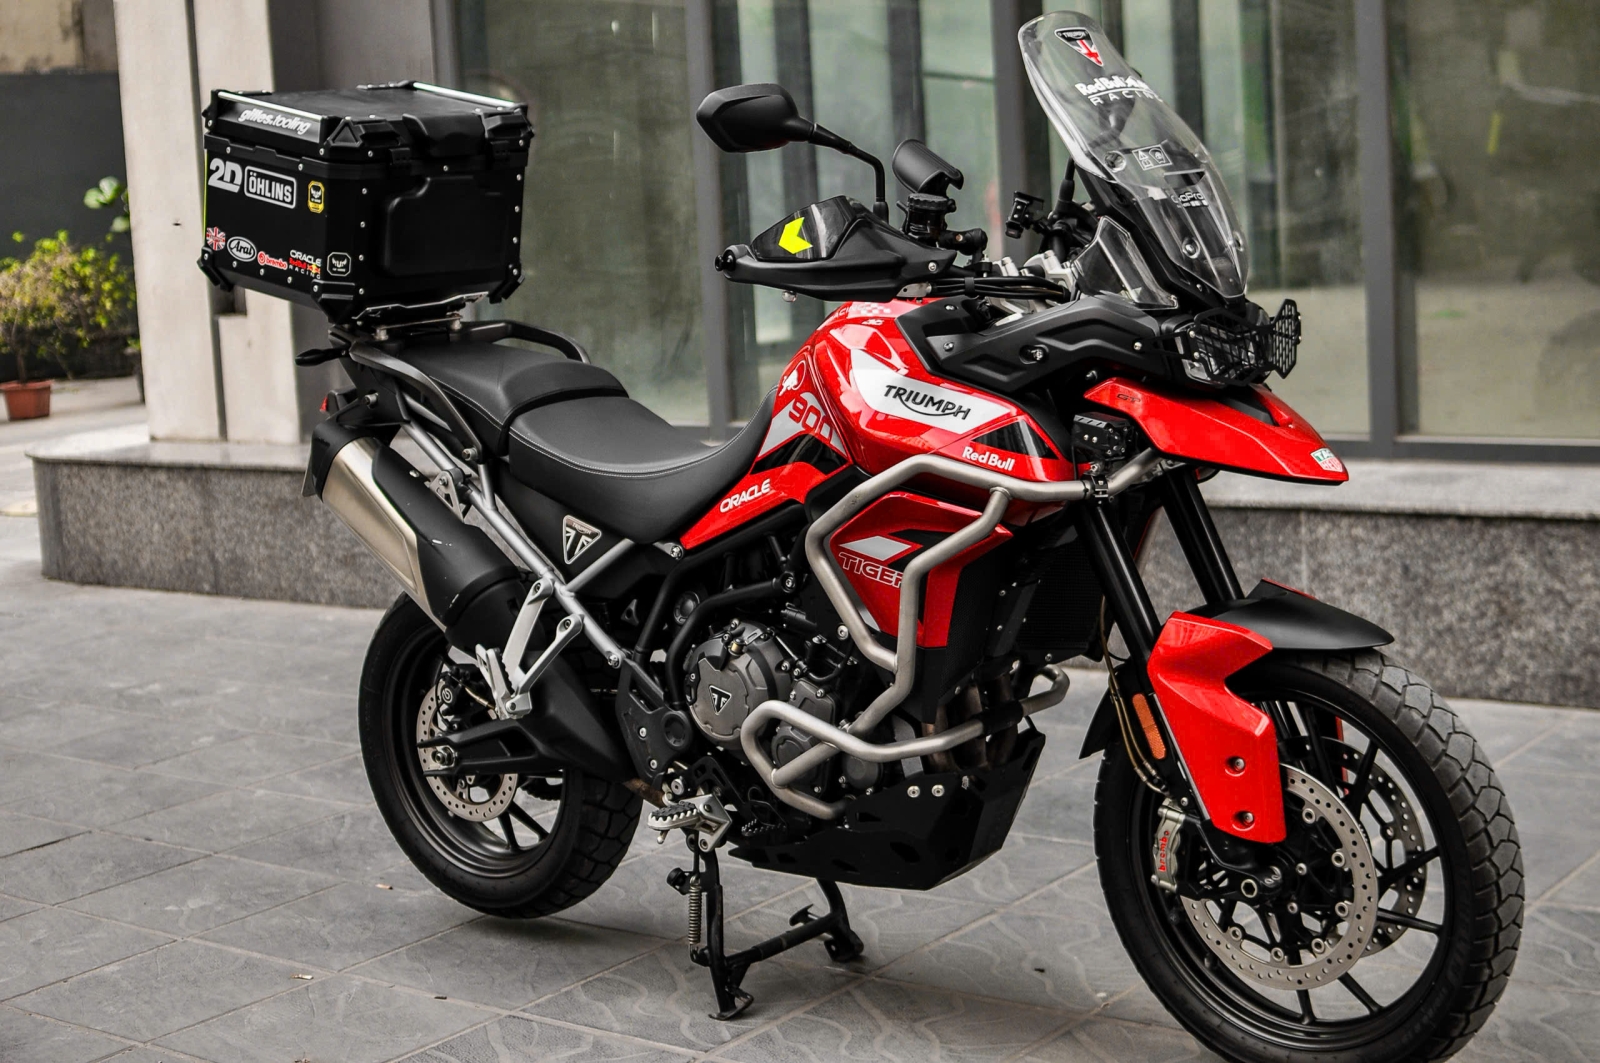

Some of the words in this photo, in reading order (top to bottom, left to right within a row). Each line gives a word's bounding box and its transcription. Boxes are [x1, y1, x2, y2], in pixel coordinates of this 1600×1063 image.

[238, 108, 312, 135] gilles.tooling
[208, 158, 242, 193] 2D
[249, 172, 292, 202] ÖHLINS
[265, 256, 287, 270] brembo
[289, 264, 321, 279] RACING
[290, 250, 322, 266] ORACLE
[884, 385, 971, 420] TRIUMPH
[789, 395, 834, 445] 900
[719, 479, 771, 513] ORACLE
[1158, 830, 1170, 872] brembo
